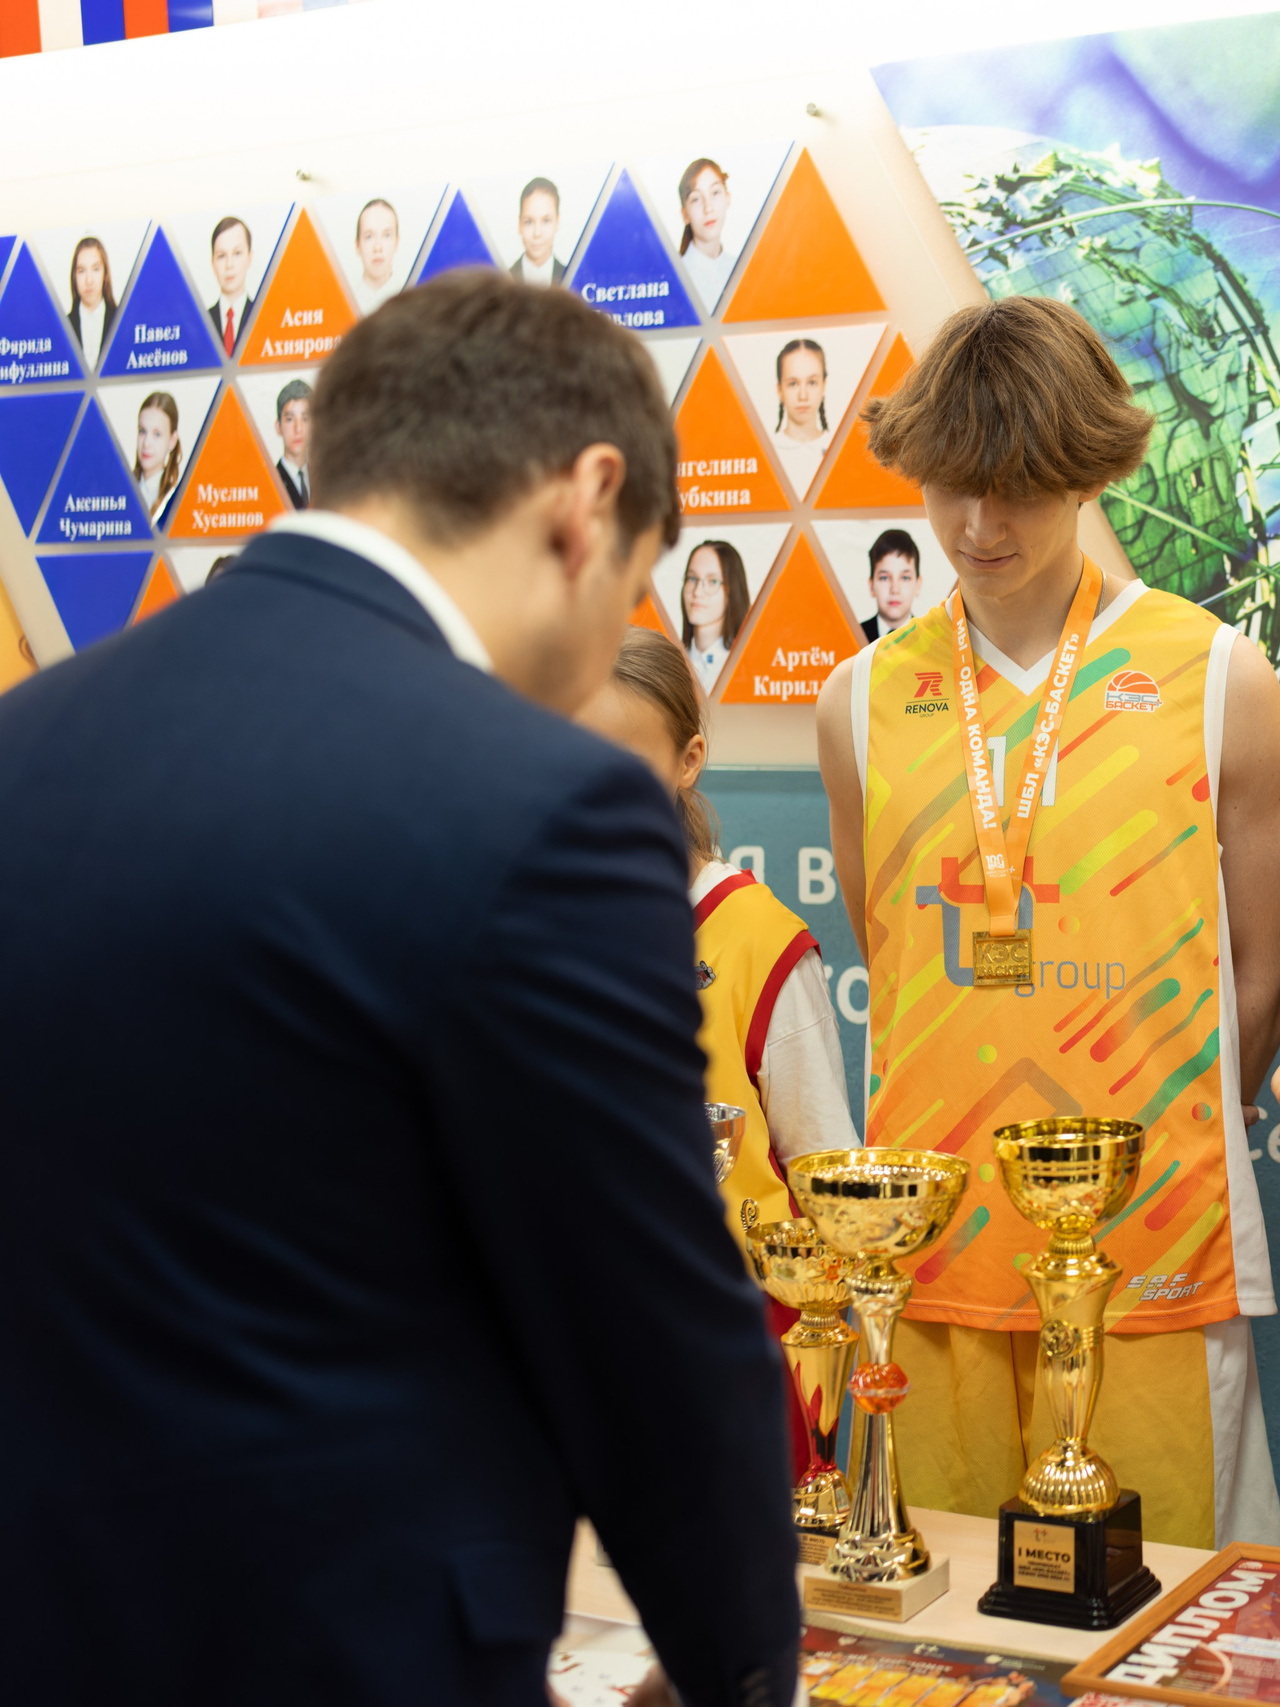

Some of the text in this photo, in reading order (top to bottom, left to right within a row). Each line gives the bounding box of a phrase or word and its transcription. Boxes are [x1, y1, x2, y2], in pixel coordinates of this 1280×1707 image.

[581, 280, 670, 303] Светлана
[281, 307, 323, 328] Асия
[134, 324, 181, 344] Павел
[126, 349, 188, 370] Аксёнов
[676, 457, 758, 478] нгелина
[197, 484, 259, 507] Муслим
[679, 485, 751, 513] убкина
[59, 517, 132, 542] Чумарина
[192, 509, 264, 533] Хусаинов
[771, 646, 835, 672] Артём
[960, 666, 978, 721] ОДНА
[905, 702, 949, 715] RENOVA
[1105, 700, 1157, 712] БАСКЕТ
[967, 724, 998, 829] КОМАНДА!
[1017, 773, 1039, 819] ШБЛ
[1139, 1281, 1204, 1301] SPORT
[1026, 1548, 1071, 1563] МЕСТО
[1104, 1569, 1277, 1688] ДИПЛОМ
